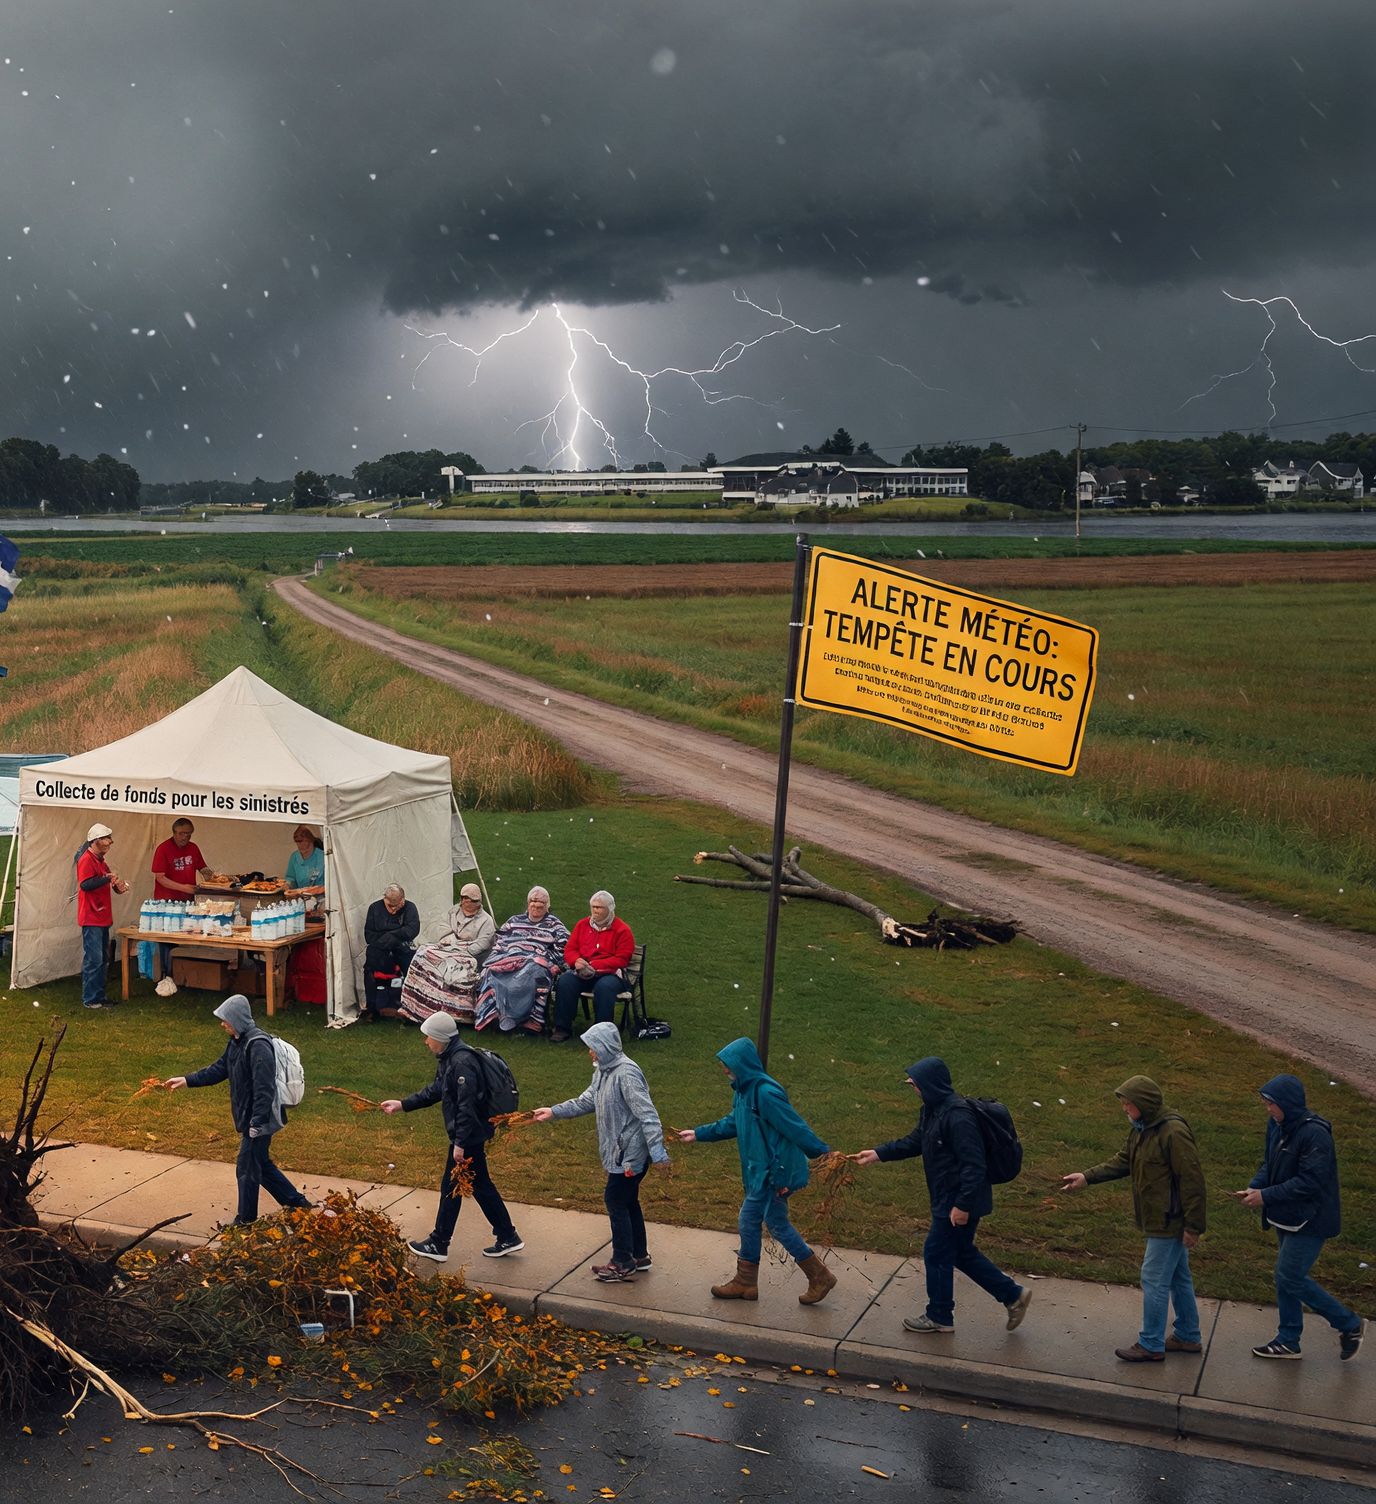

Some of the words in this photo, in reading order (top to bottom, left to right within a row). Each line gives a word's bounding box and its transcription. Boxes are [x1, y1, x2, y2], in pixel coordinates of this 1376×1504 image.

[823, 609, 938, 667] TEMPÊTE
[942, 640, 978, 677] EN
[984, 653, 1077, 702] COURS
[850, 577, 952, 629] ALERTE
[960, 606, 1059, 660] MÉTÉO:
[35, 779, 96, 801] Collecte
[101, 783, 120, 801] de
[124, 785, 167, 805] fonds
[172, 791, 208, 809] pour
[212, 791, 235, 810] les
[239, 793, 310, 815] sinistrés
